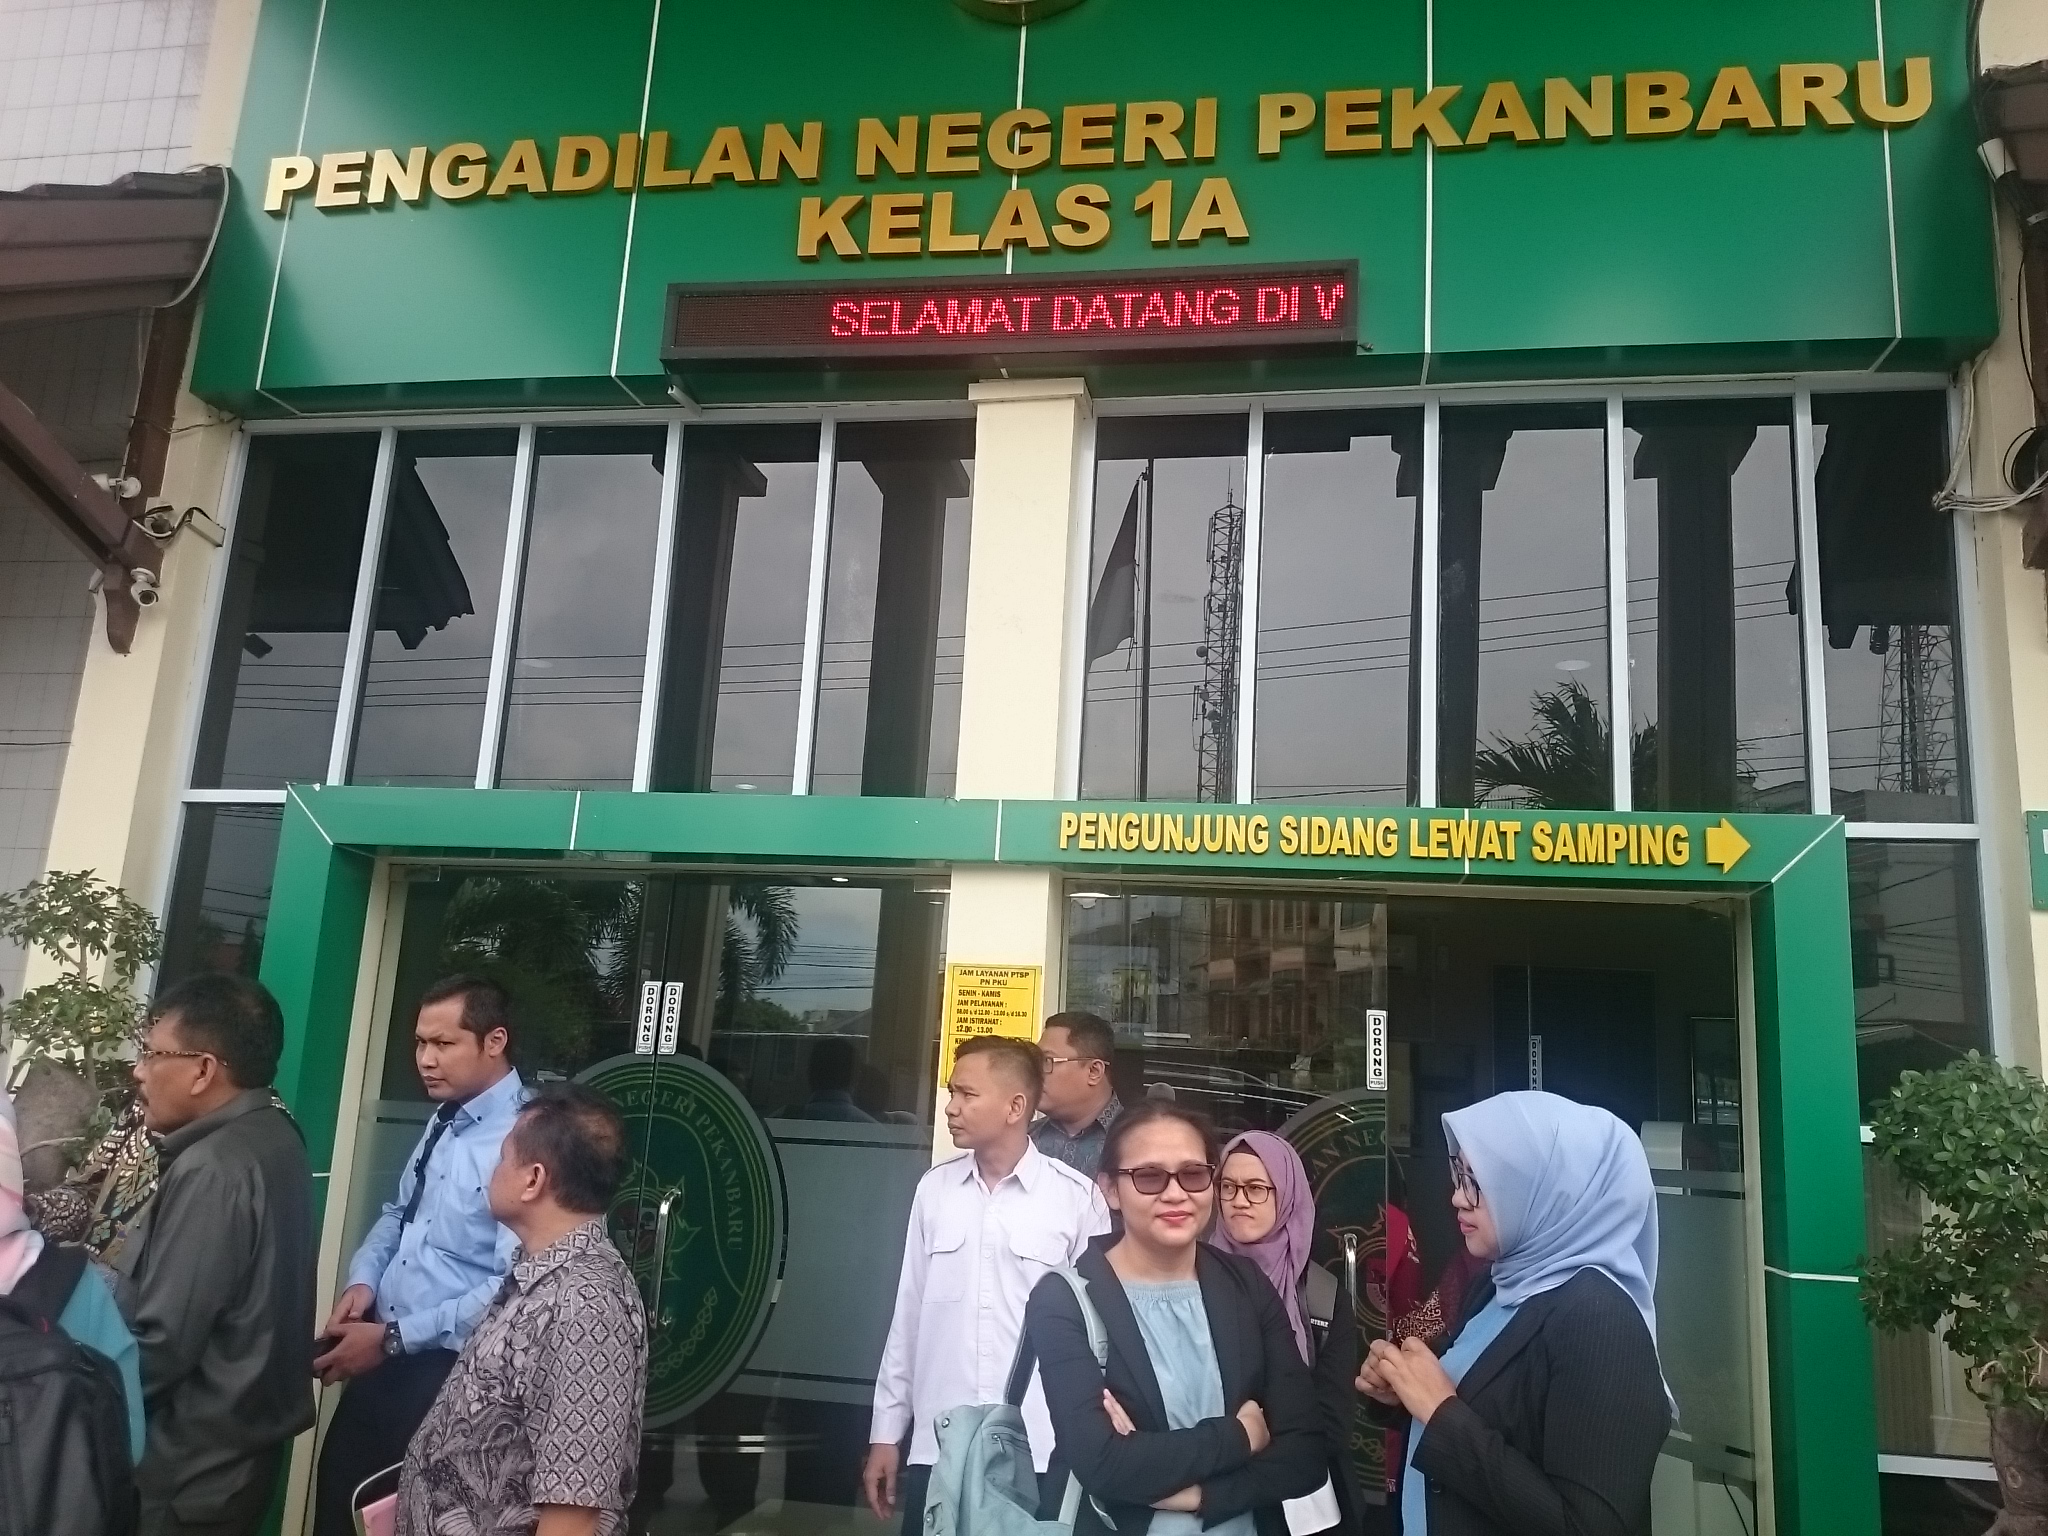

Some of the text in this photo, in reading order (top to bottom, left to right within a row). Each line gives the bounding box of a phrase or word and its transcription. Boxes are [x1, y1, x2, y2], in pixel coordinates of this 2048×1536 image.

[263, 57, 1933, 217] PENGADILAN NEGERI PEKANBARU
[796, 177, 1250, 259] KELAS 1A
[831, 296, 1041, 336] SELAMAT
[1053, 289, 1240, 332] DATANG
[1256, 286, 1298, 323] DI
[1059, 812, 1690, 866] PENGUNJUNG SIDANG LEWAT SAMPING
[958, 989, 977, 997] SENIN
[981, 990, 1001, 998] KAMIS
[975, 970, 1009, 978] LAYANAN
[1010, 971, 1030, 979] PTSP
[642, 987, 655, 1042] DORONG
[664, 988, 678, 1043] DORONG
[956, 1016, 969, 1024] JAM
[969, 1017, 999, 1025] ISTIRAHAT
[970, 1000, 1004, 1008] PELAYANAN
[976, 1026, 993, 1034] 13.00
[1372, 1017, 1383, 1077] DORONG
[695, 1113, 744, 1251] PEKANBARU
